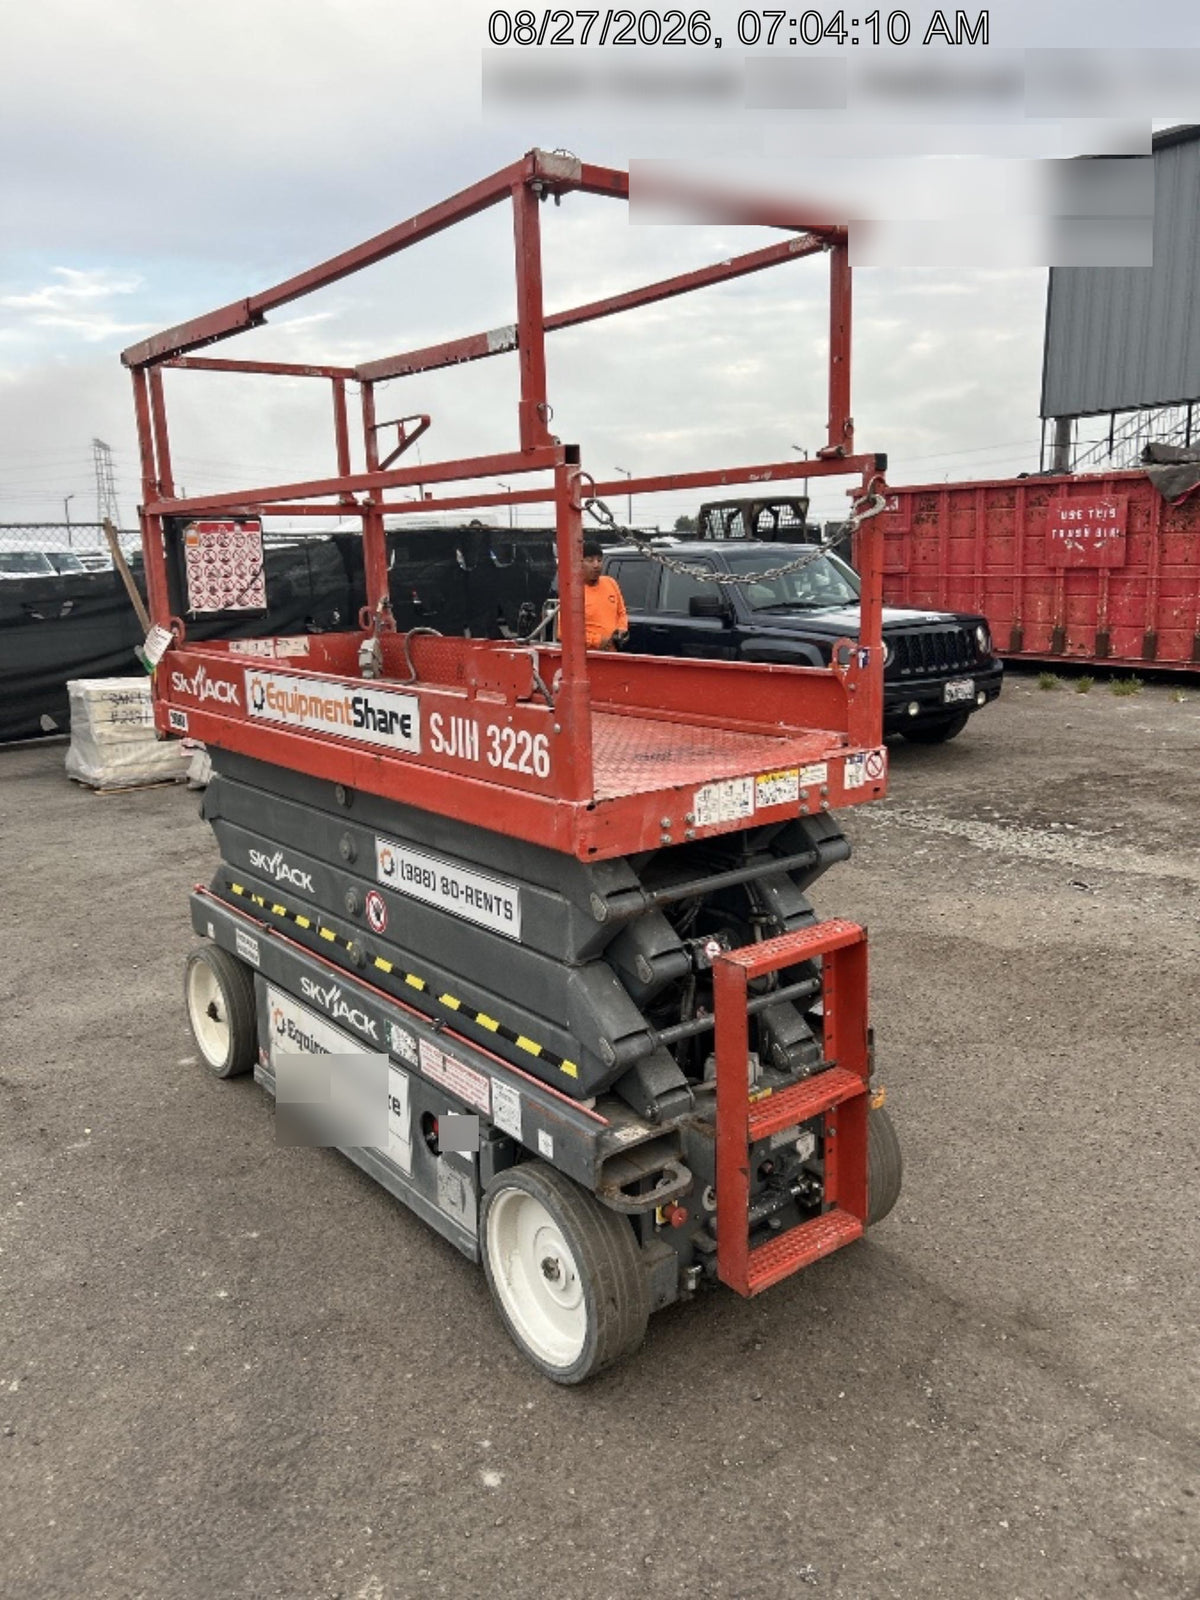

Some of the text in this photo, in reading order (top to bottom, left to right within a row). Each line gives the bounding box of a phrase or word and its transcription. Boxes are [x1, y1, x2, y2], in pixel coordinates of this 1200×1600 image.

[1061, 509, 1084, 520] USE
[171, 665, 240, 706] SKYJACK
[265, 681, 412, 739] EquipmentShare
[486, 724, 550, 778] 3226
[248, 849, 316, 893] SKYJACK
[300, 976, 379, 1041] SKYJACK
